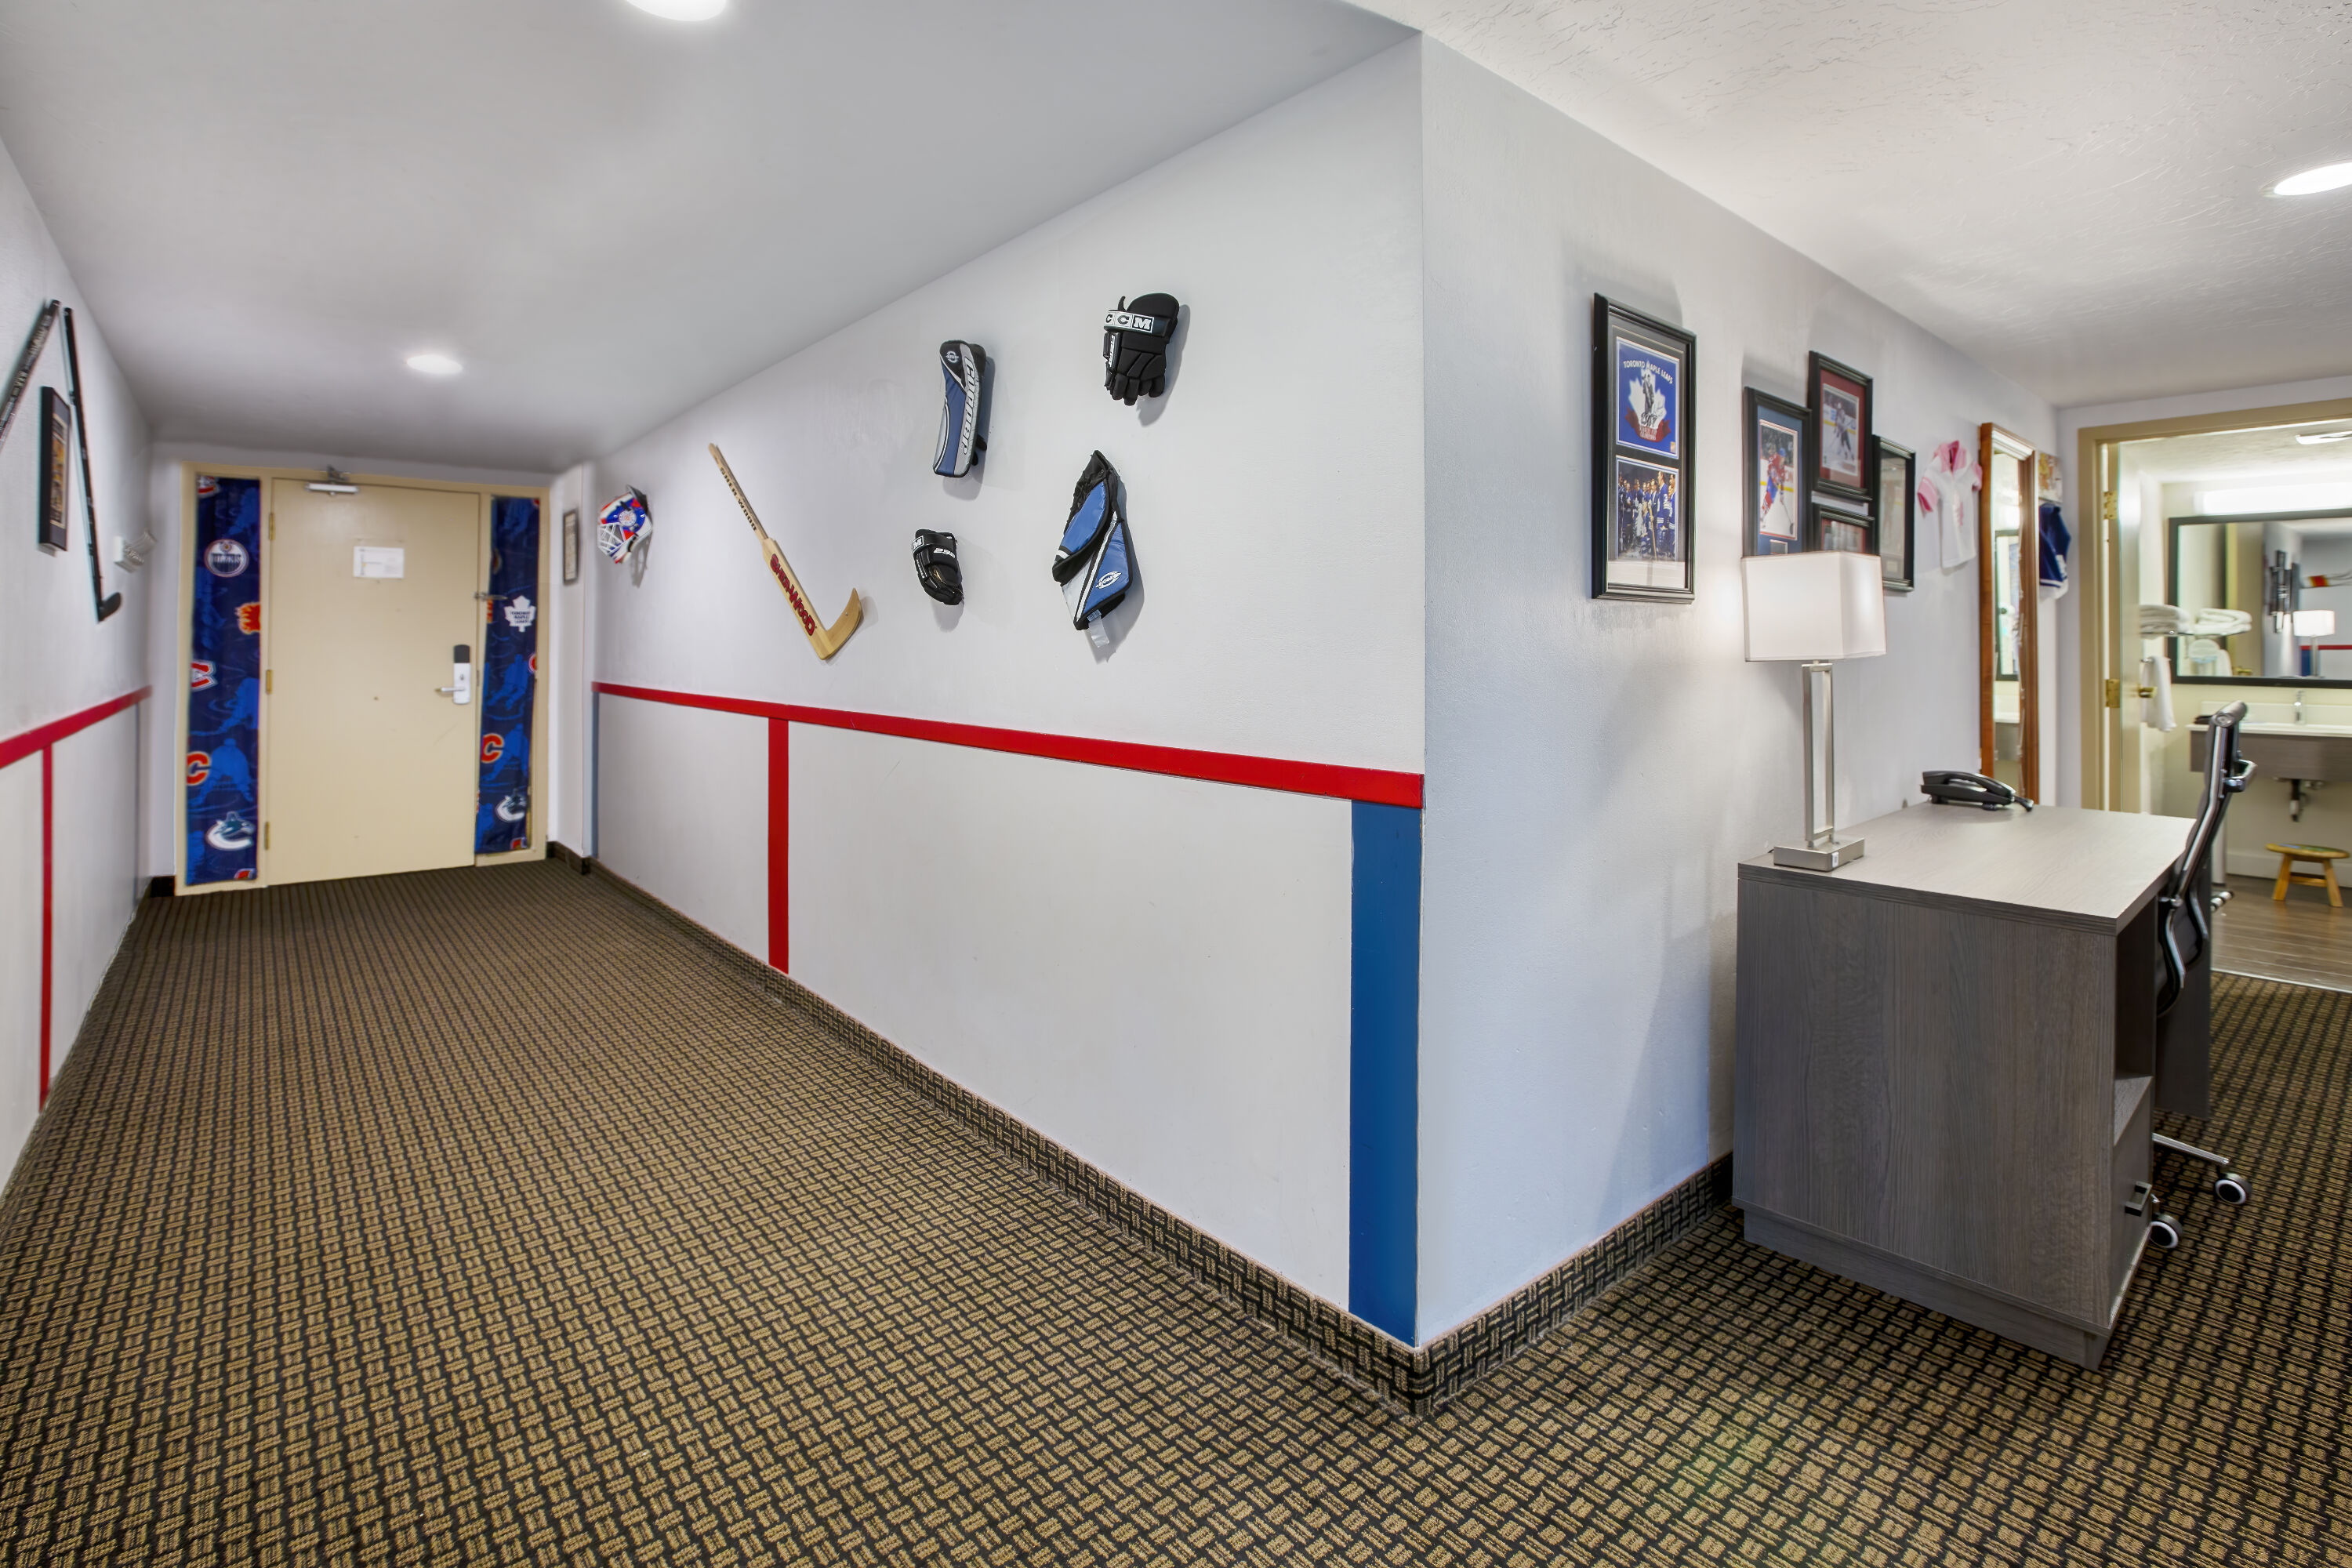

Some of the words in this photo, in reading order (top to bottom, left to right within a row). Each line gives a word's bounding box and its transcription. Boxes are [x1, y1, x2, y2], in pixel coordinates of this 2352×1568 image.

[1105, 313, 1152, 330] CCM
[1623, 360, 1646, 368] TORONTO
[1661, 369, 1673, 384] LEAFS
